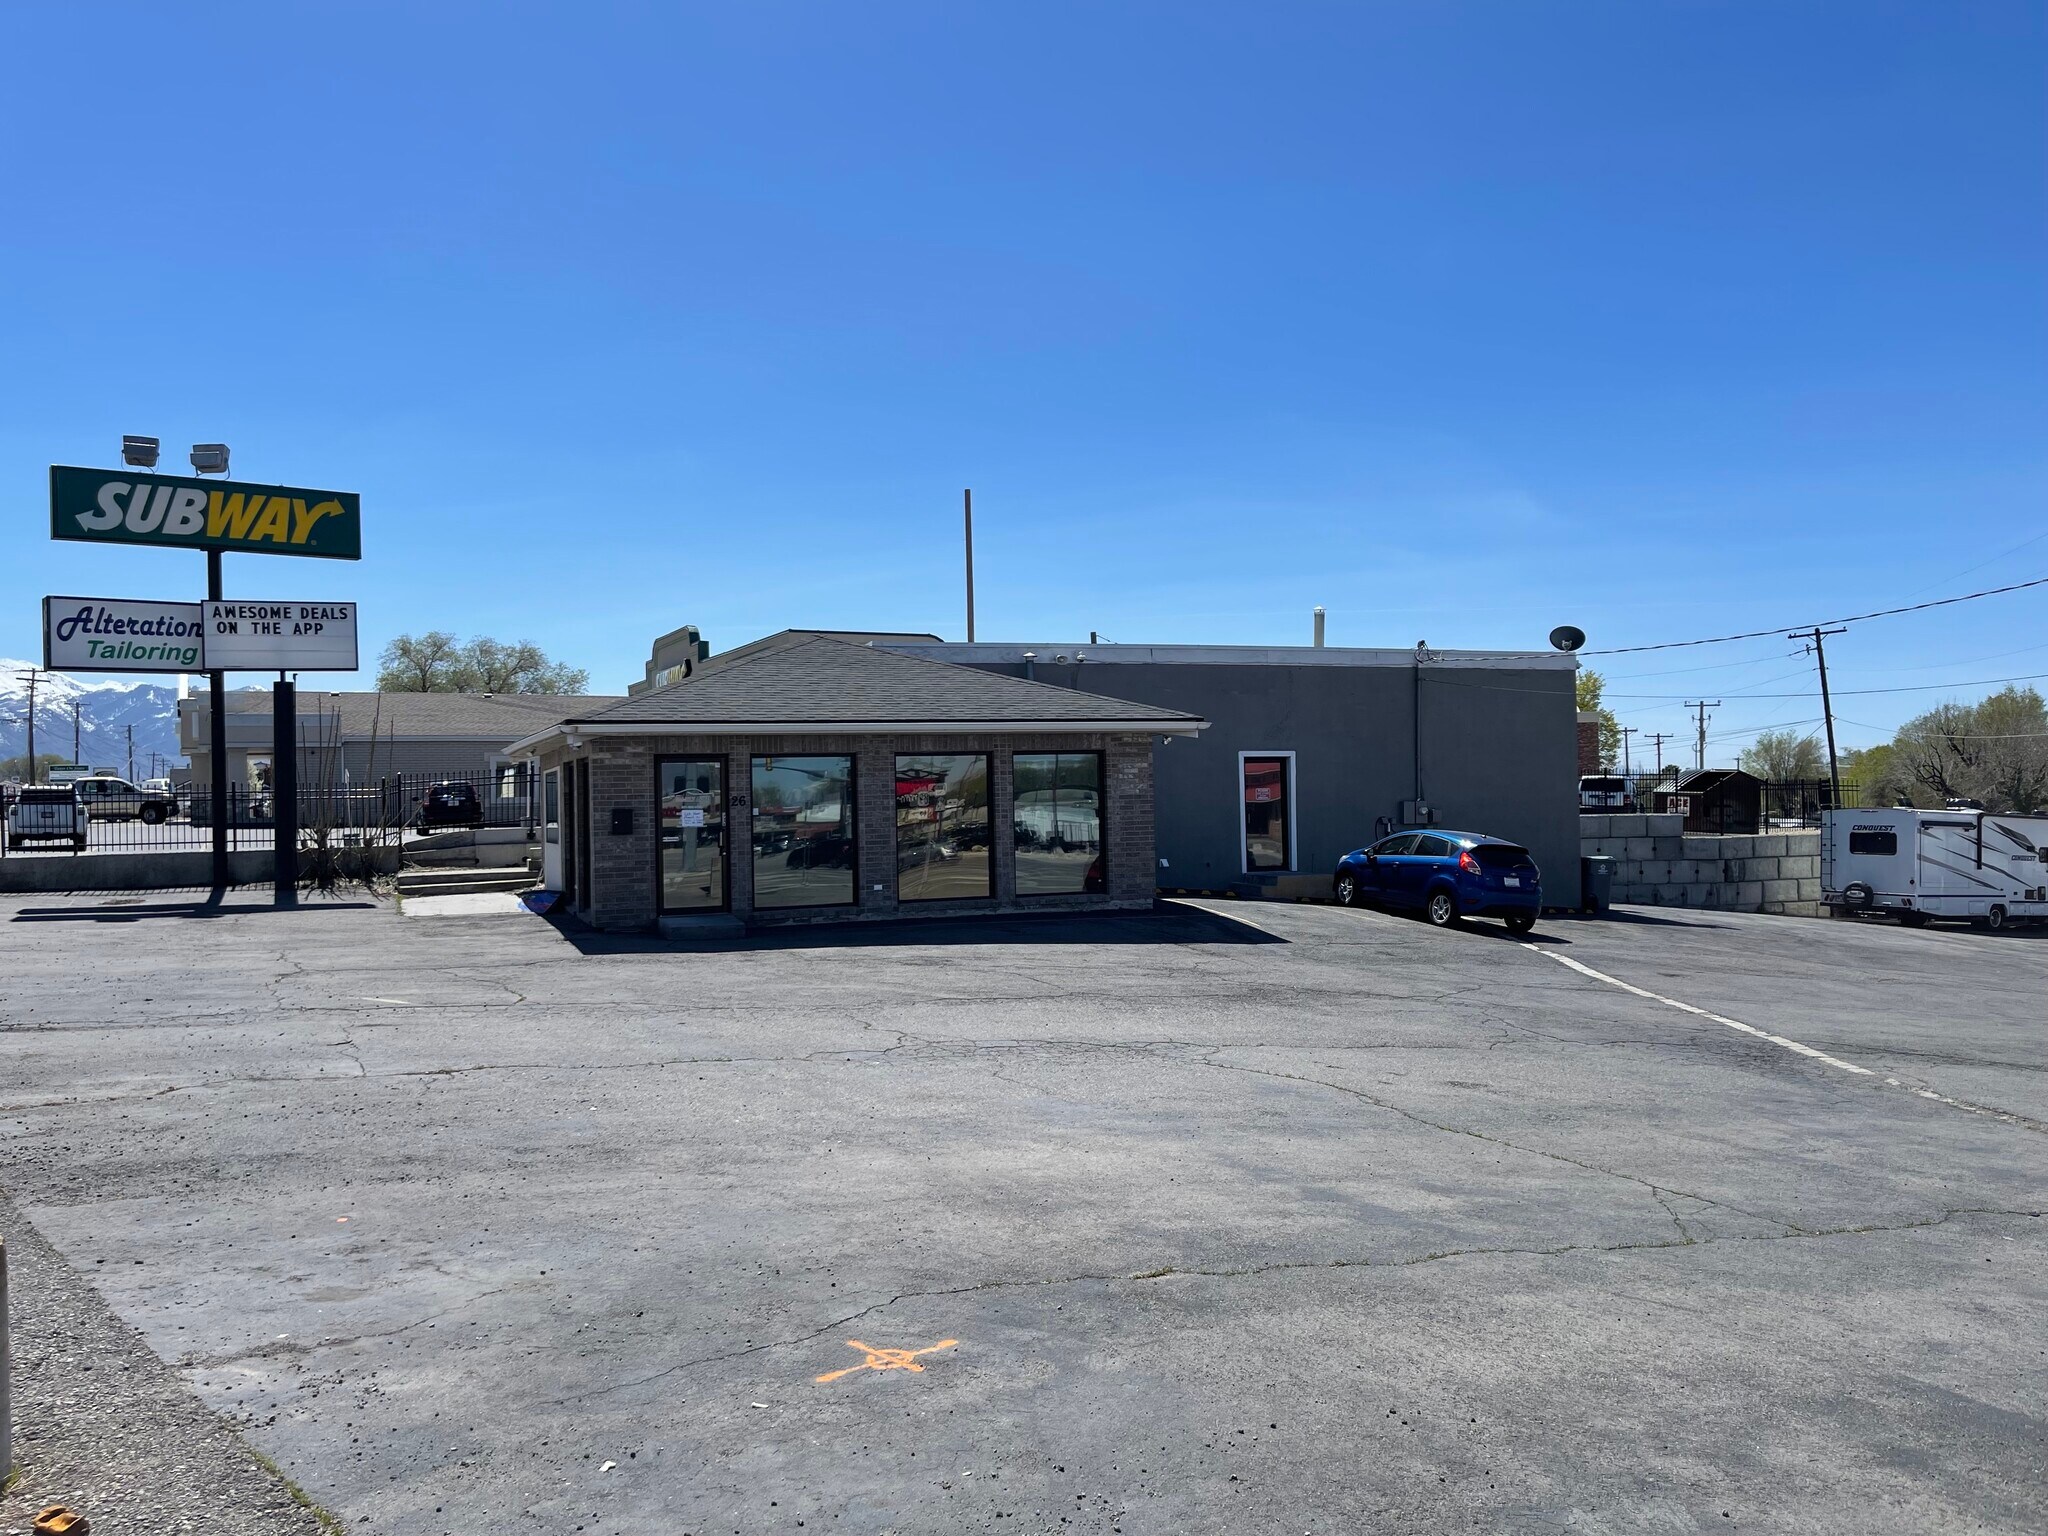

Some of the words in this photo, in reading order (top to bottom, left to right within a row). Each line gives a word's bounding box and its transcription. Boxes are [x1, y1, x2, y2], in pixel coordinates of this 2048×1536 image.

[75, 481, 345, 544] SUBWAY
[213, 606, 292, 619] AWESOME
[300, 607, 348, 620] DEALS
[56, 606, 203, 641] Alteration
[217, 621, 238, 634] ON
[251, 622, 281, 635] THE
[293, 622, 324, 635] APP
[88, 640, 199, 665] Tailoring
[731, 795, 746, 807] 26
